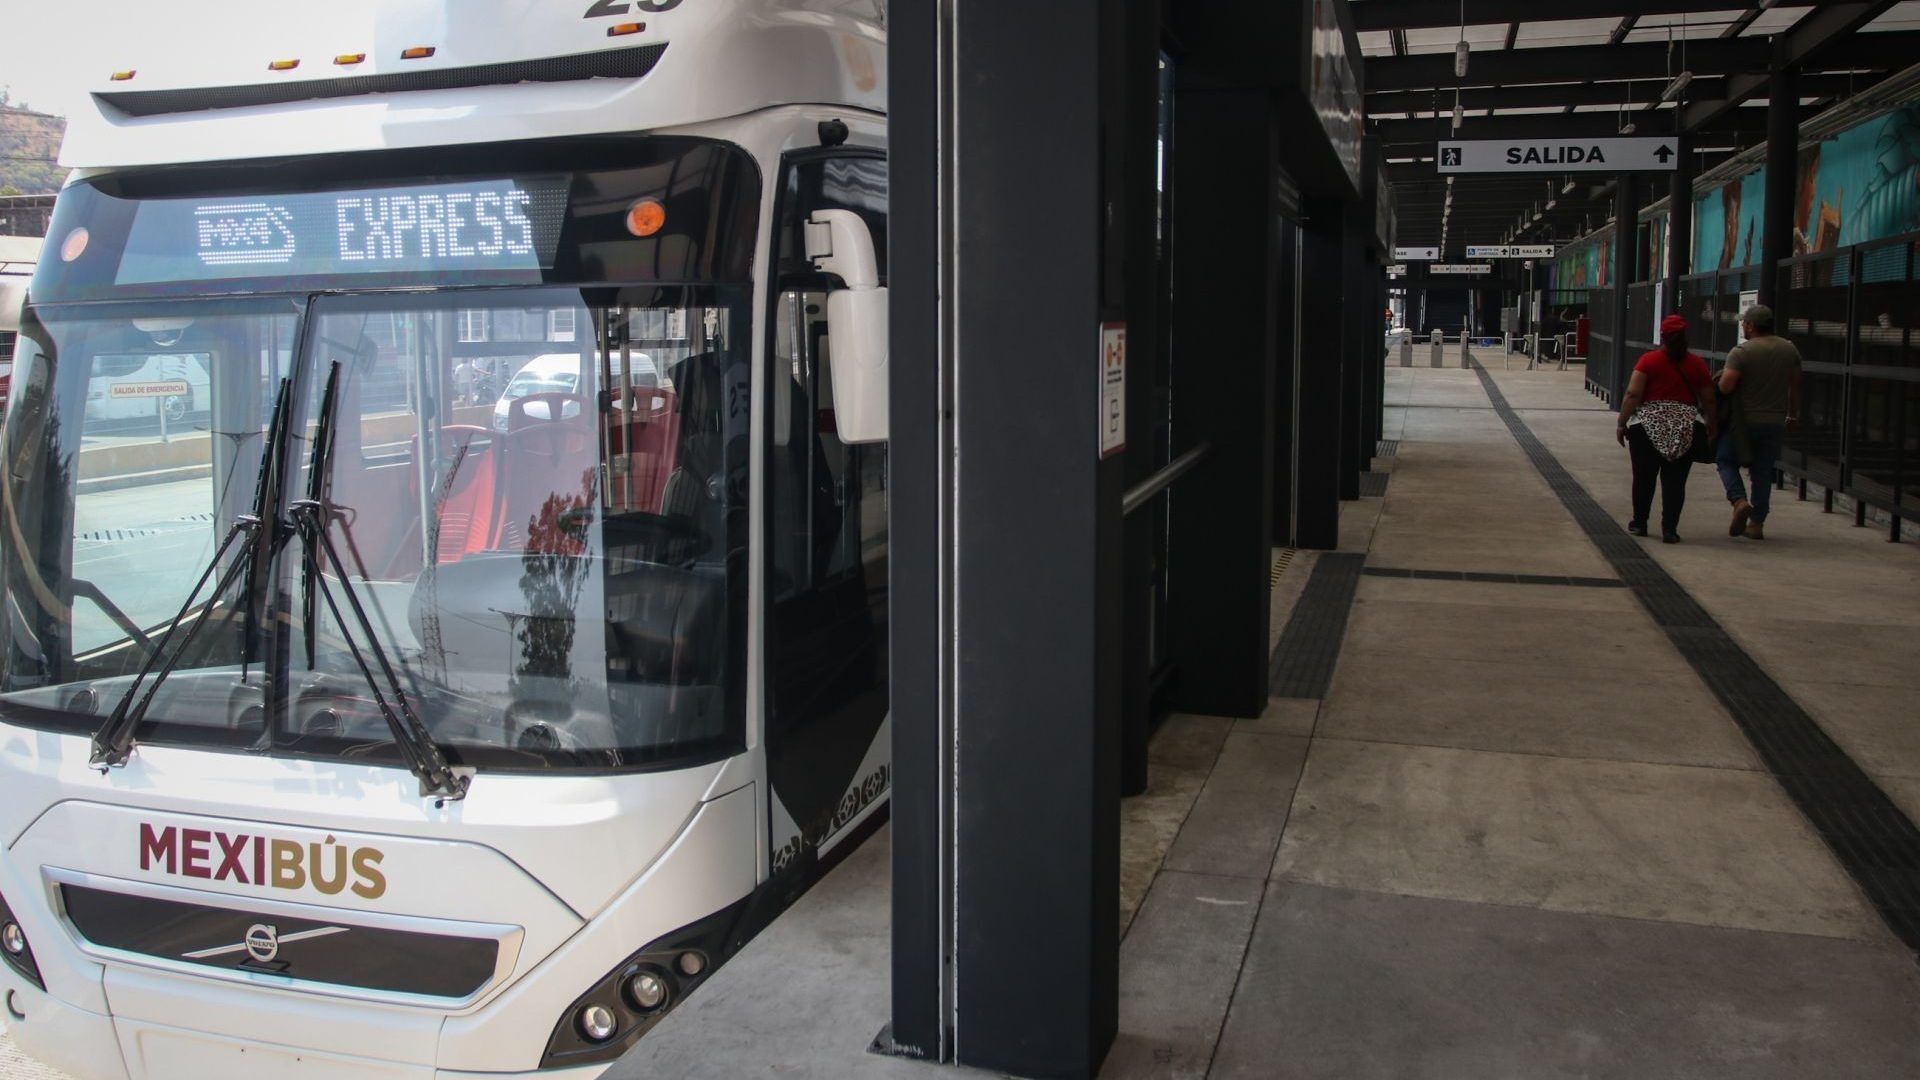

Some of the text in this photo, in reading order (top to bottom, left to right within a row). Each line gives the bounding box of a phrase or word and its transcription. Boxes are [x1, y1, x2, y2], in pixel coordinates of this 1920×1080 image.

[1506, 145, 1605, 164] SALIDA
[336, 190, 533, 261] EXPRESS
[114, 384, 185, 394] SALIDA DE EMERGENCIA
[140, 823, 387, 900] MEXIBÚS
[247, 938, 275, 948] VOLVO
